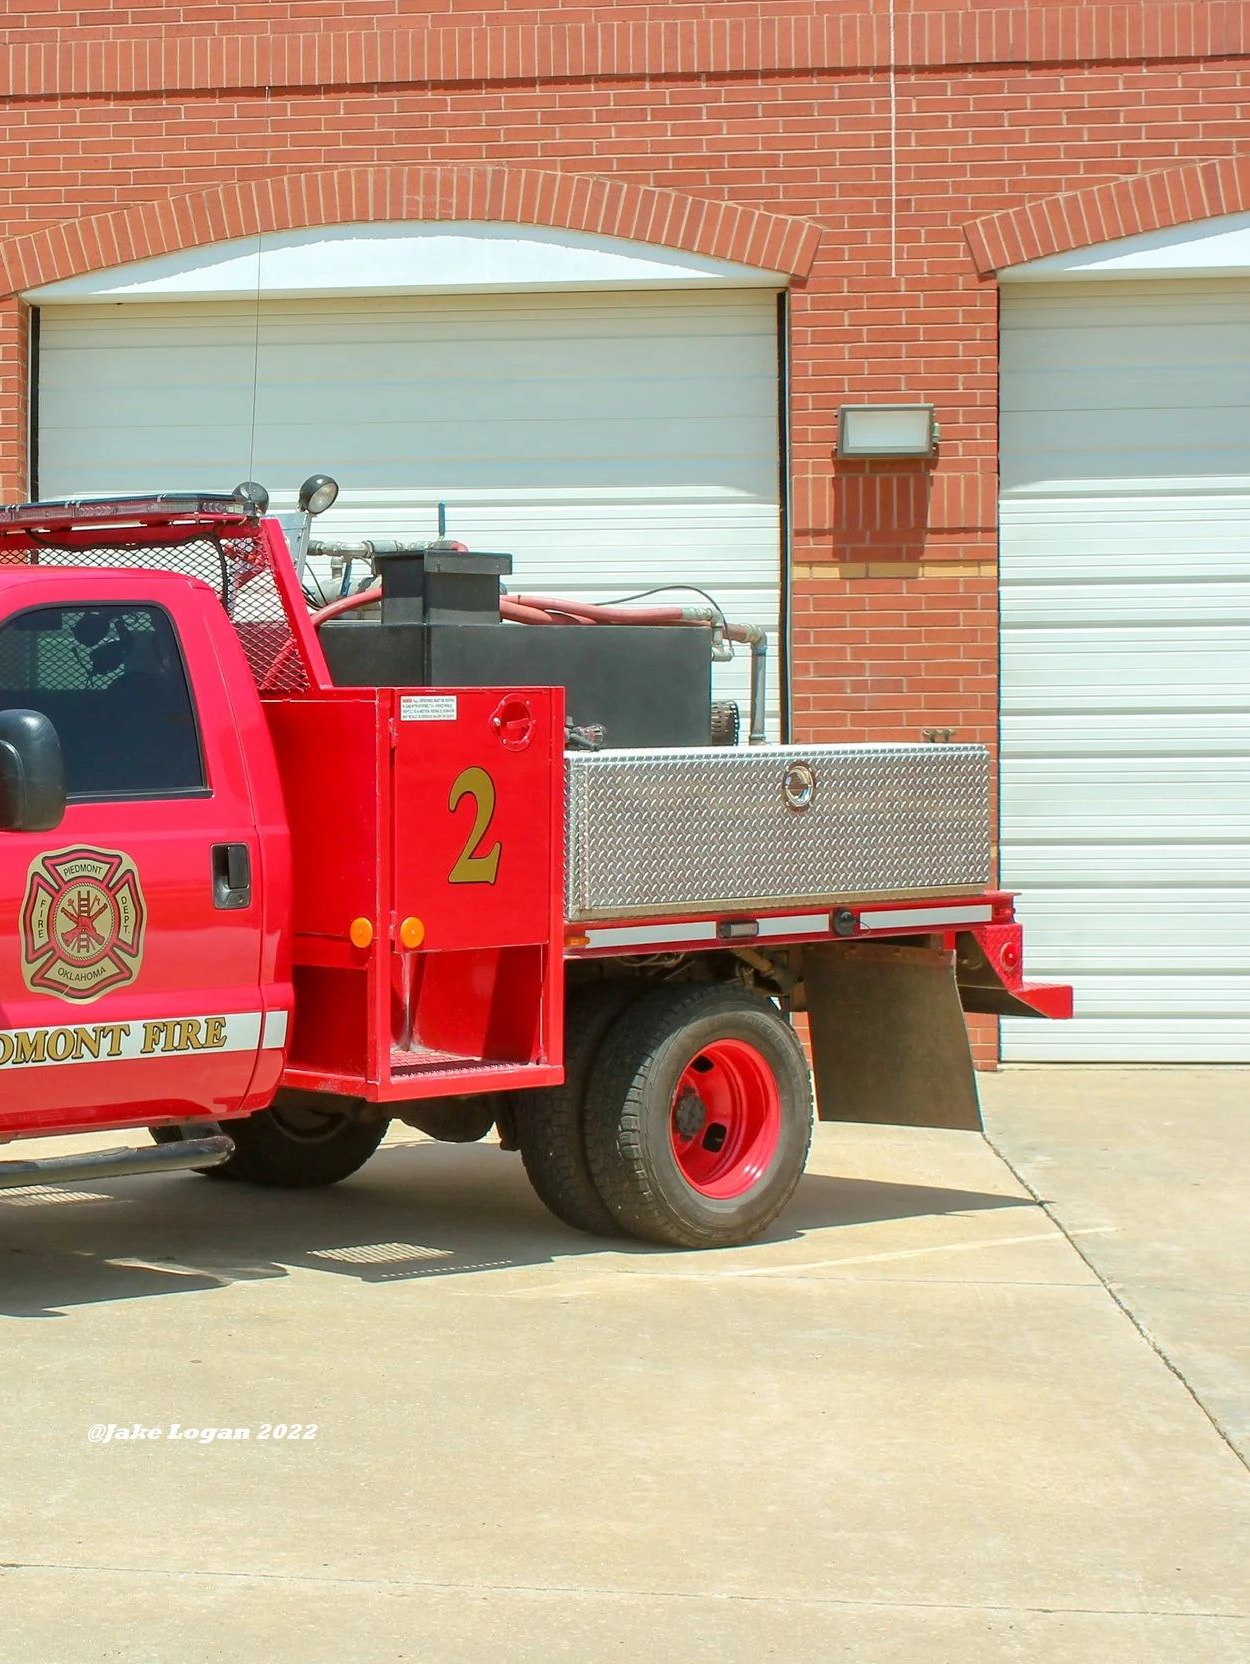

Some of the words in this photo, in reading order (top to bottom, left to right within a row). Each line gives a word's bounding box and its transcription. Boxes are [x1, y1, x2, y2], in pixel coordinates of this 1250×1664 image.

[448, 765, 502, 886] 2
[63, 864, 103, 877] PIEDMONT
[38, 899, 47, 938] FIRE
[57, 966, 107, 981] OKLAHOMA
[140, 1016, 229, 1054] FIRE
